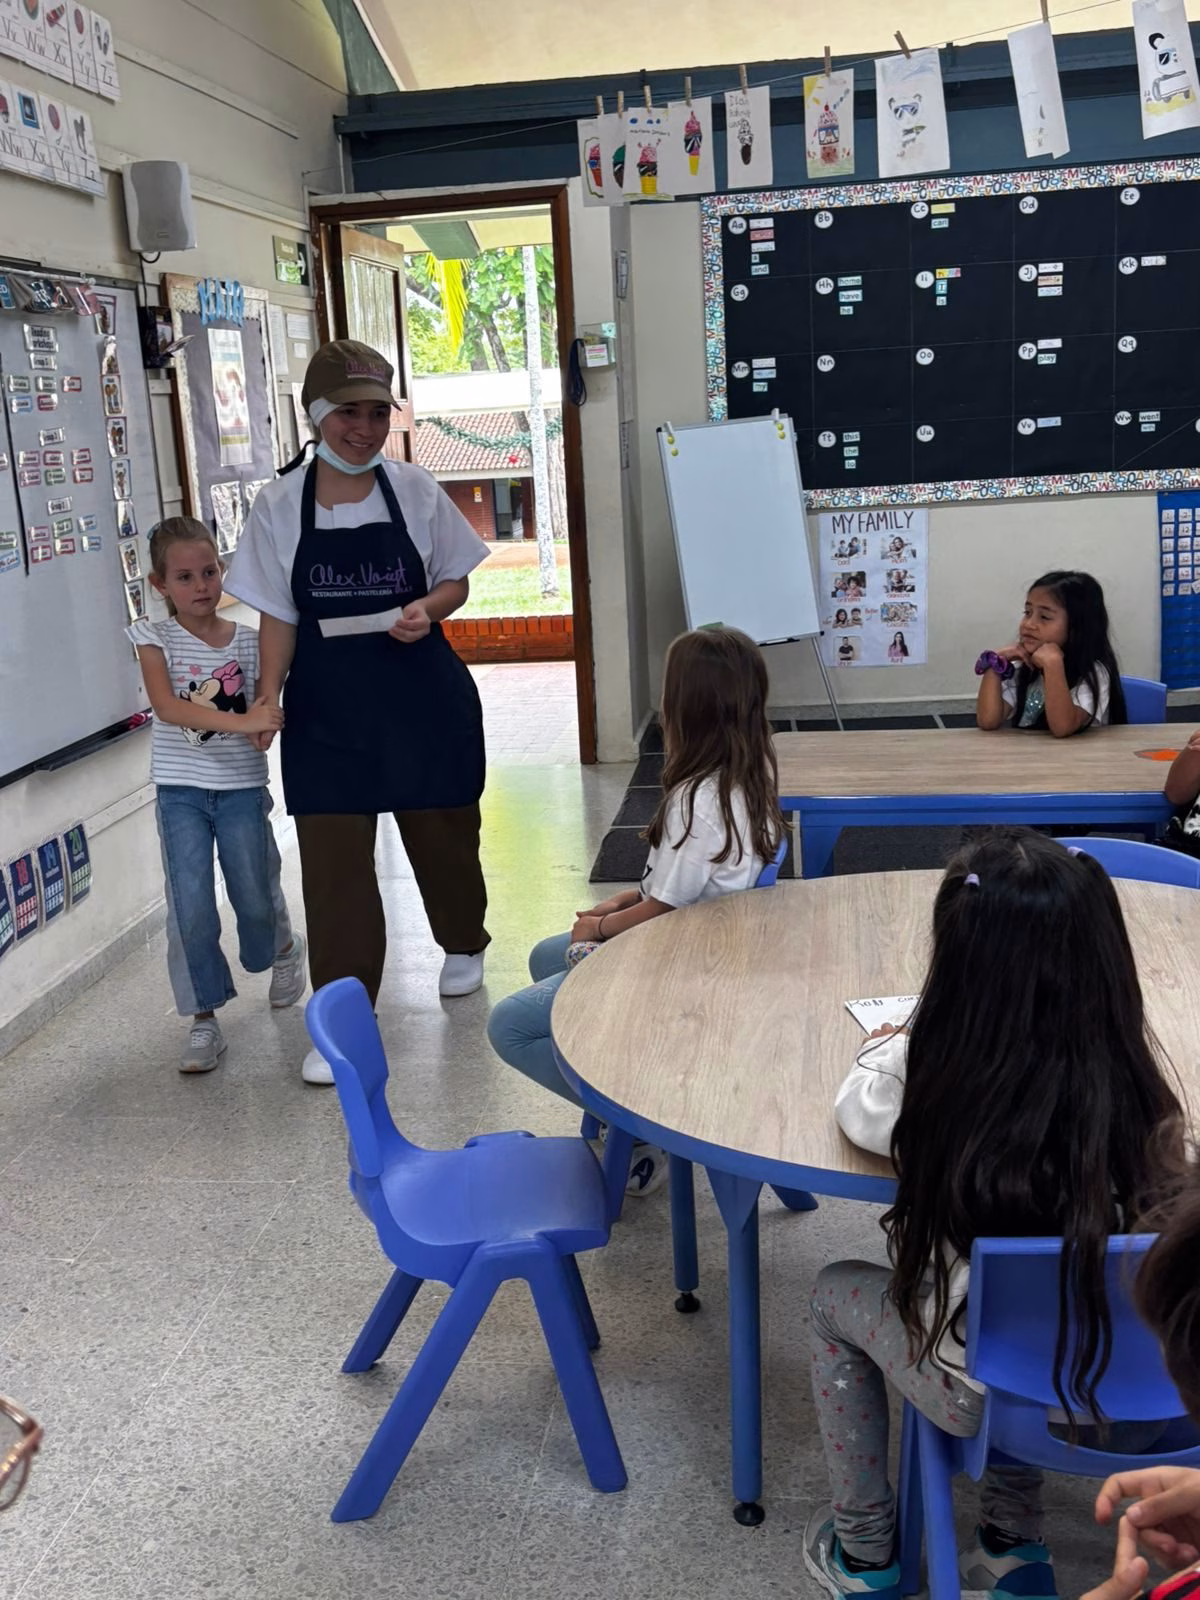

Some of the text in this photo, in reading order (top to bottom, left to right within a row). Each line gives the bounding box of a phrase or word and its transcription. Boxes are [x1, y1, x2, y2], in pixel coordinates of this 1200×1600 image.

[832, 511, 914, 534] MY FAMILY
[312, 590, 353, 598] RESTAURANTE
